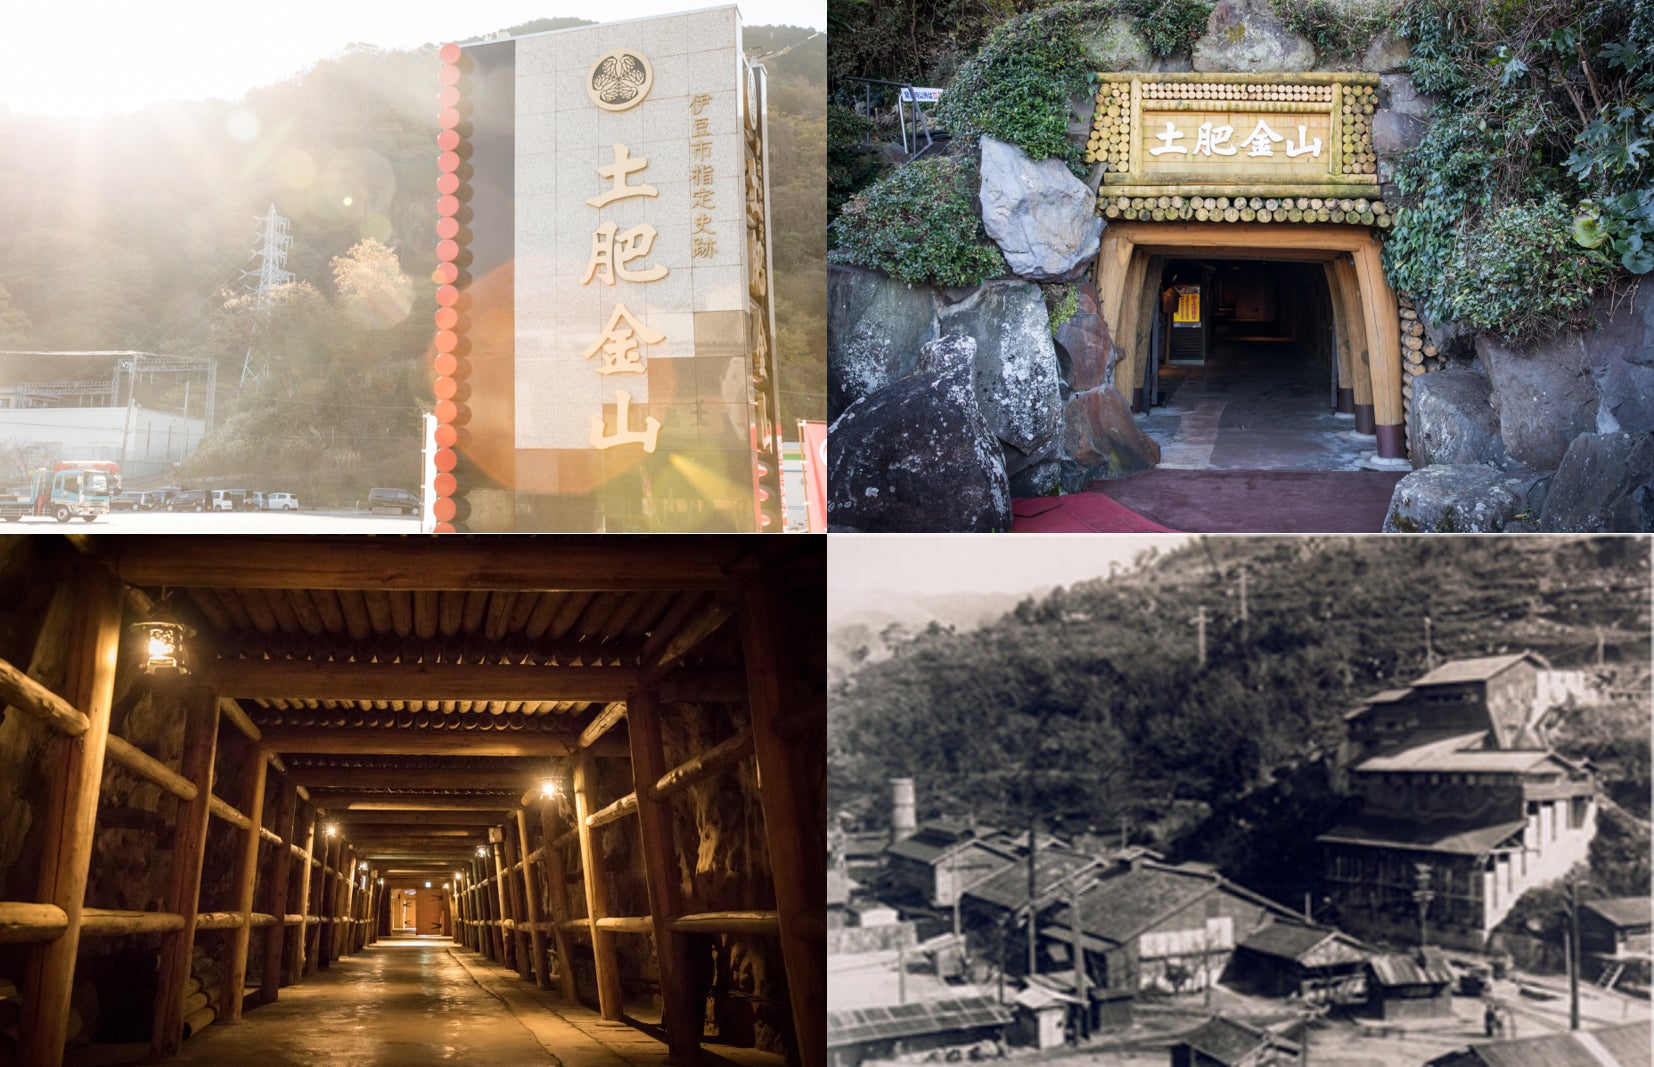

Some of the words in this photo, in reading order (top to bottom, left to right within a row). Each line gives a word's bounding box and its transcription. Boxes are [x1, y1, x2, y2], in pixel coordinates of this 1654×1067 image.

[689, 93, 718, 260] 伊豆市指定史跡
[1149, 119, 1323, 159] 土肥金山
[581, 143, 669, 454] 土肥金山
